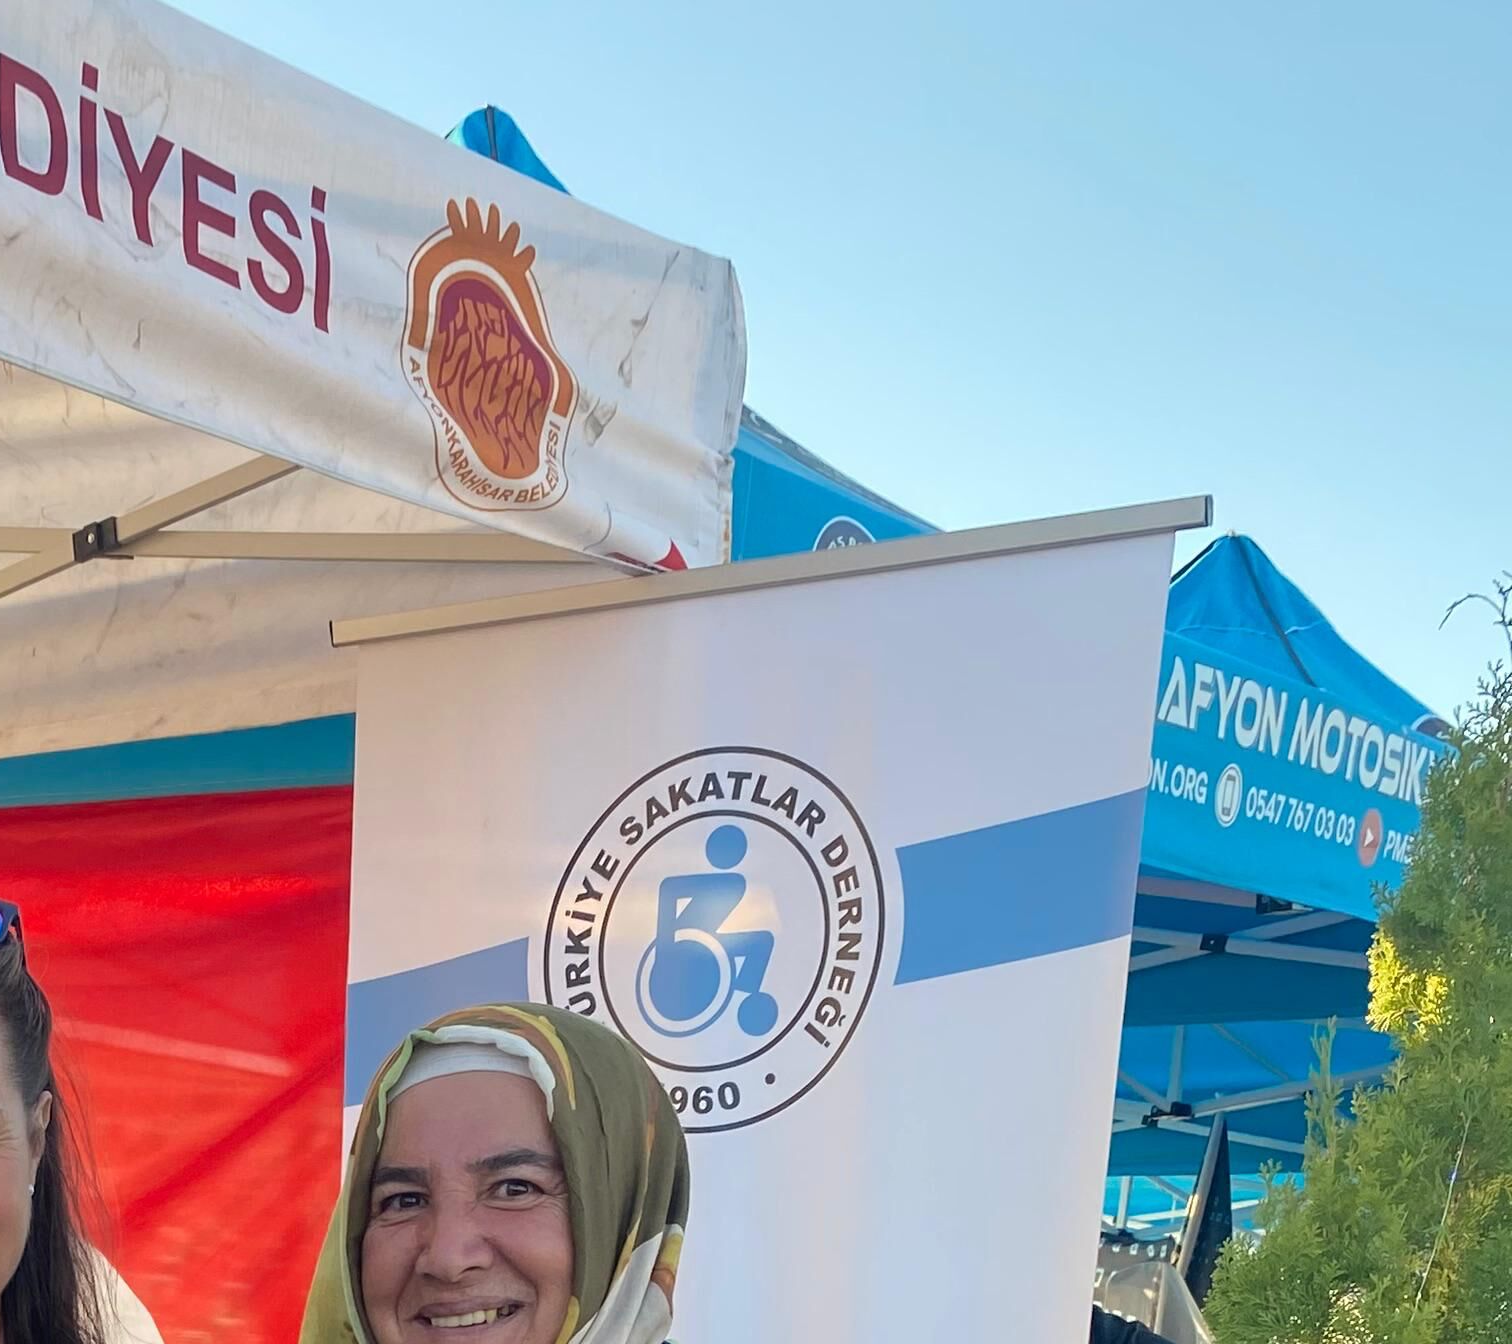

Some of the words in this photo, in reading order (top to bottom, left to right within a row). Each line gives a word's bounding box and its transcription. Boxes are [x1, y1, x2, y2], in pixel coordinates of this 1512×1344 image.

[1157, 655, 1288, 757] AFYON
[1245, 786, 1286, 825] 0547
[1286, 797, 1314, 833] 767
[1314, 806, 1335, 840] 03
[1336, 813, 1355, 846] 03
[563, 848, 622, 1016] ÜRKİYE
[619, 771, 826, 846] SAKATLAR
[803, 834, 864, 1049] DERNEĞİ
[669, 1081, 741, 1114] 960
